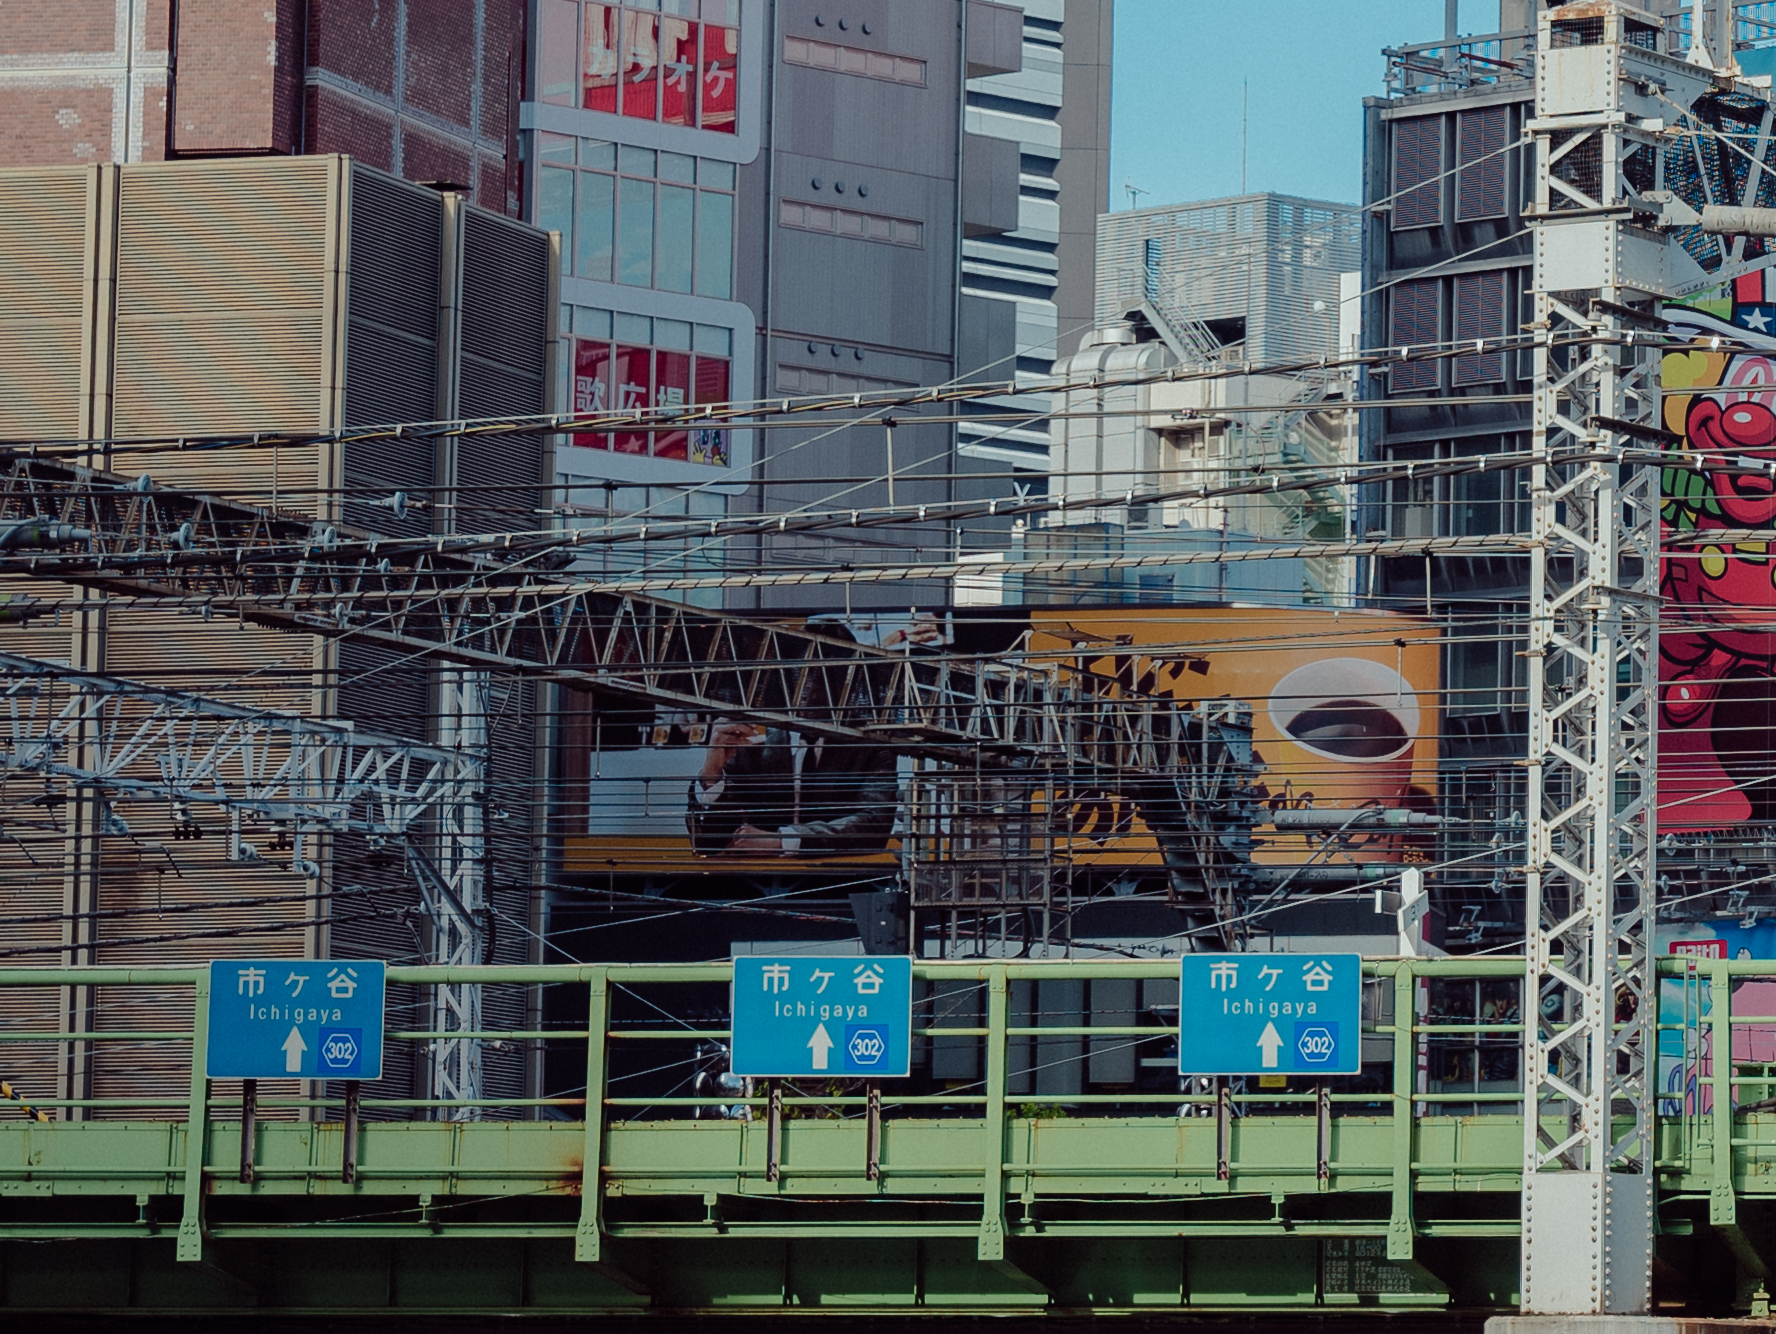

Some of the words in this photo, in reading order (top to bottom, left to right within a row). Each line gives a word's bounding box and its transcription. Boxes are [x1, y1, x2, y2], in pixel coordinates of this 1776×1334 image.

[587, 43, 736, 99] カラオケ
[249, 1003, 343, 1023] Ichigaya
[774, 1001, 869, 1021] Ichigaya
[1222, 998, 1318, 1018] Ichigaya
[326, 1041, 354, 1059] 302
[853, 1038, 880, 1058] 302
[1302, 1035, 1330, 1055] 302
